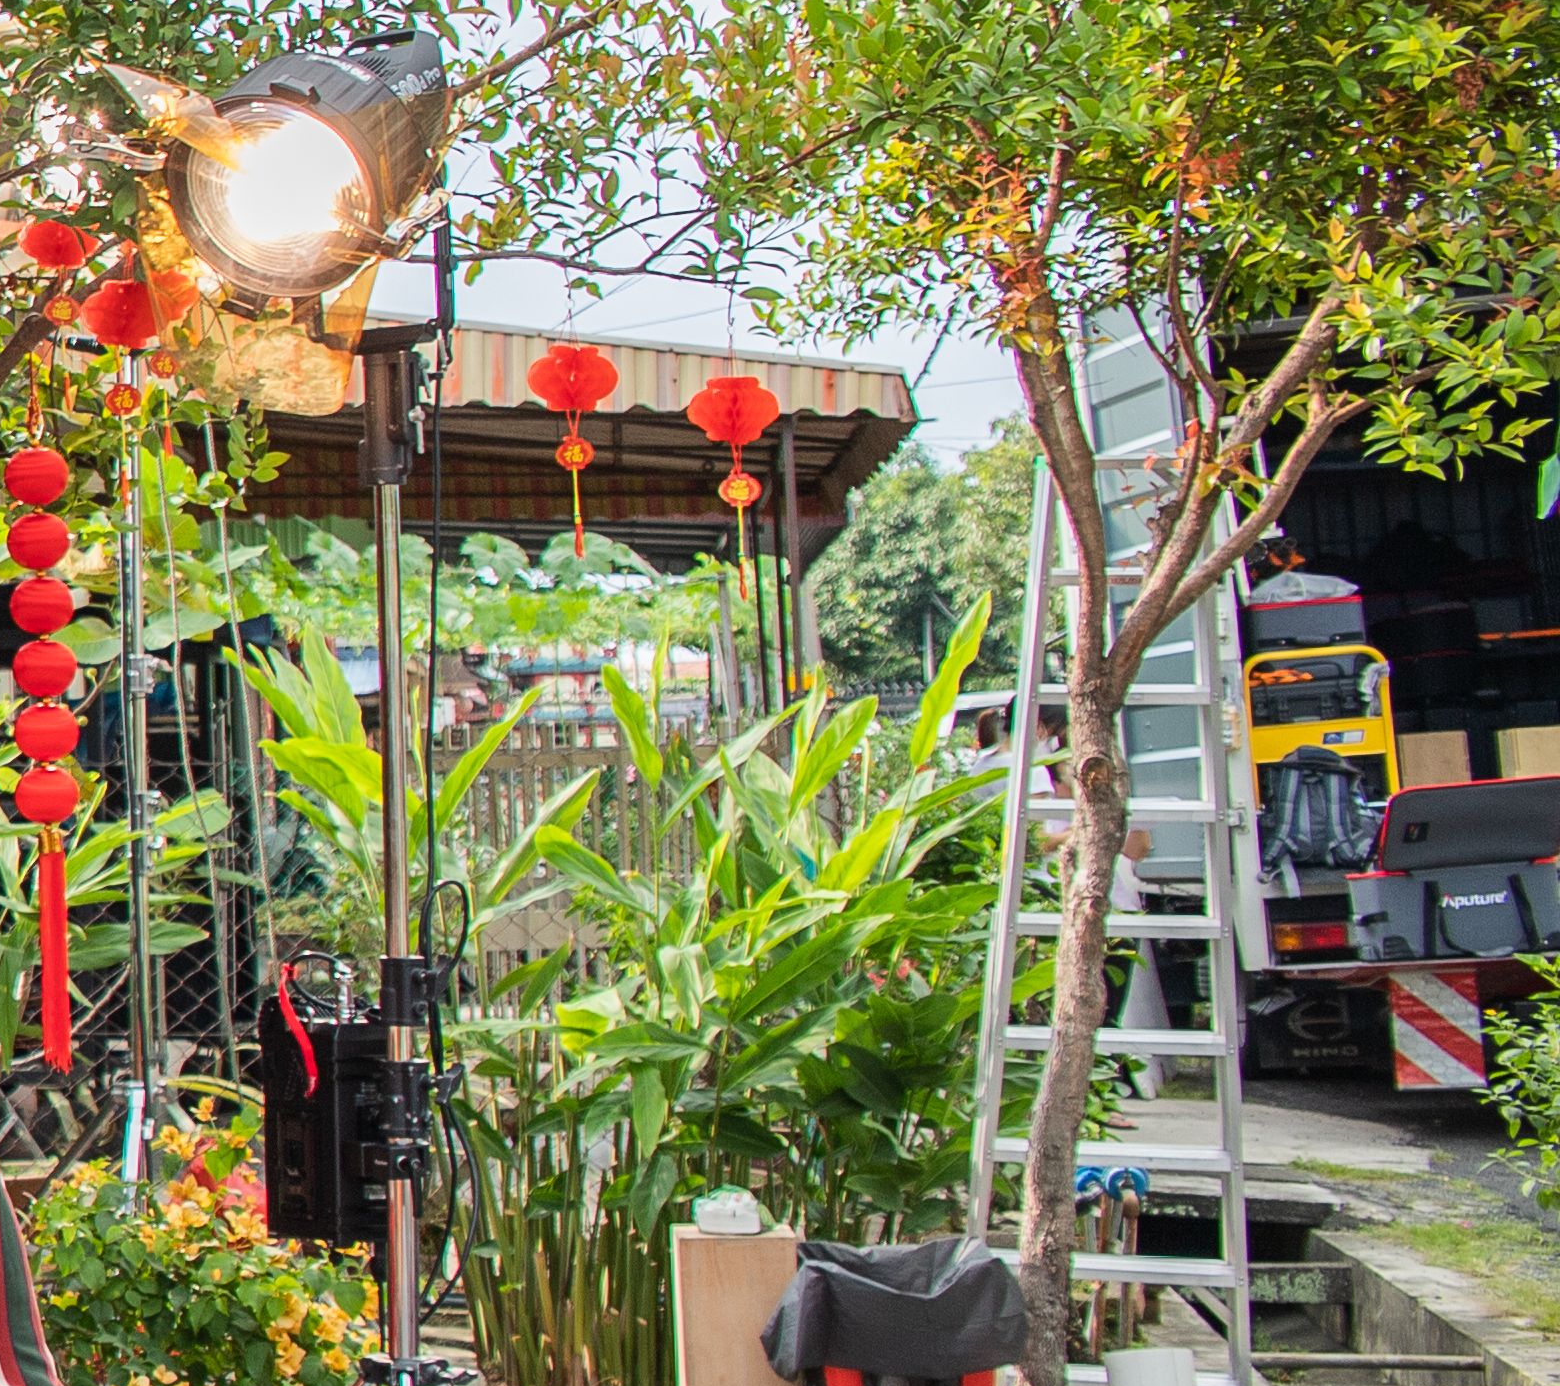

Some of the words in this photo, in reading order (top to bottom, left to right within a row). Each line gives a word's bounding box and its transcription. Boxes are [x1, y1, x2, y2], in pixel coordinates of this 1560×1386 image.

[423, 67, 441, 85] Pro
[114, 389, 133, 409] 福
[564, 444, 584, 463] 福
[1440, 890, 1508, 910] Aputure
